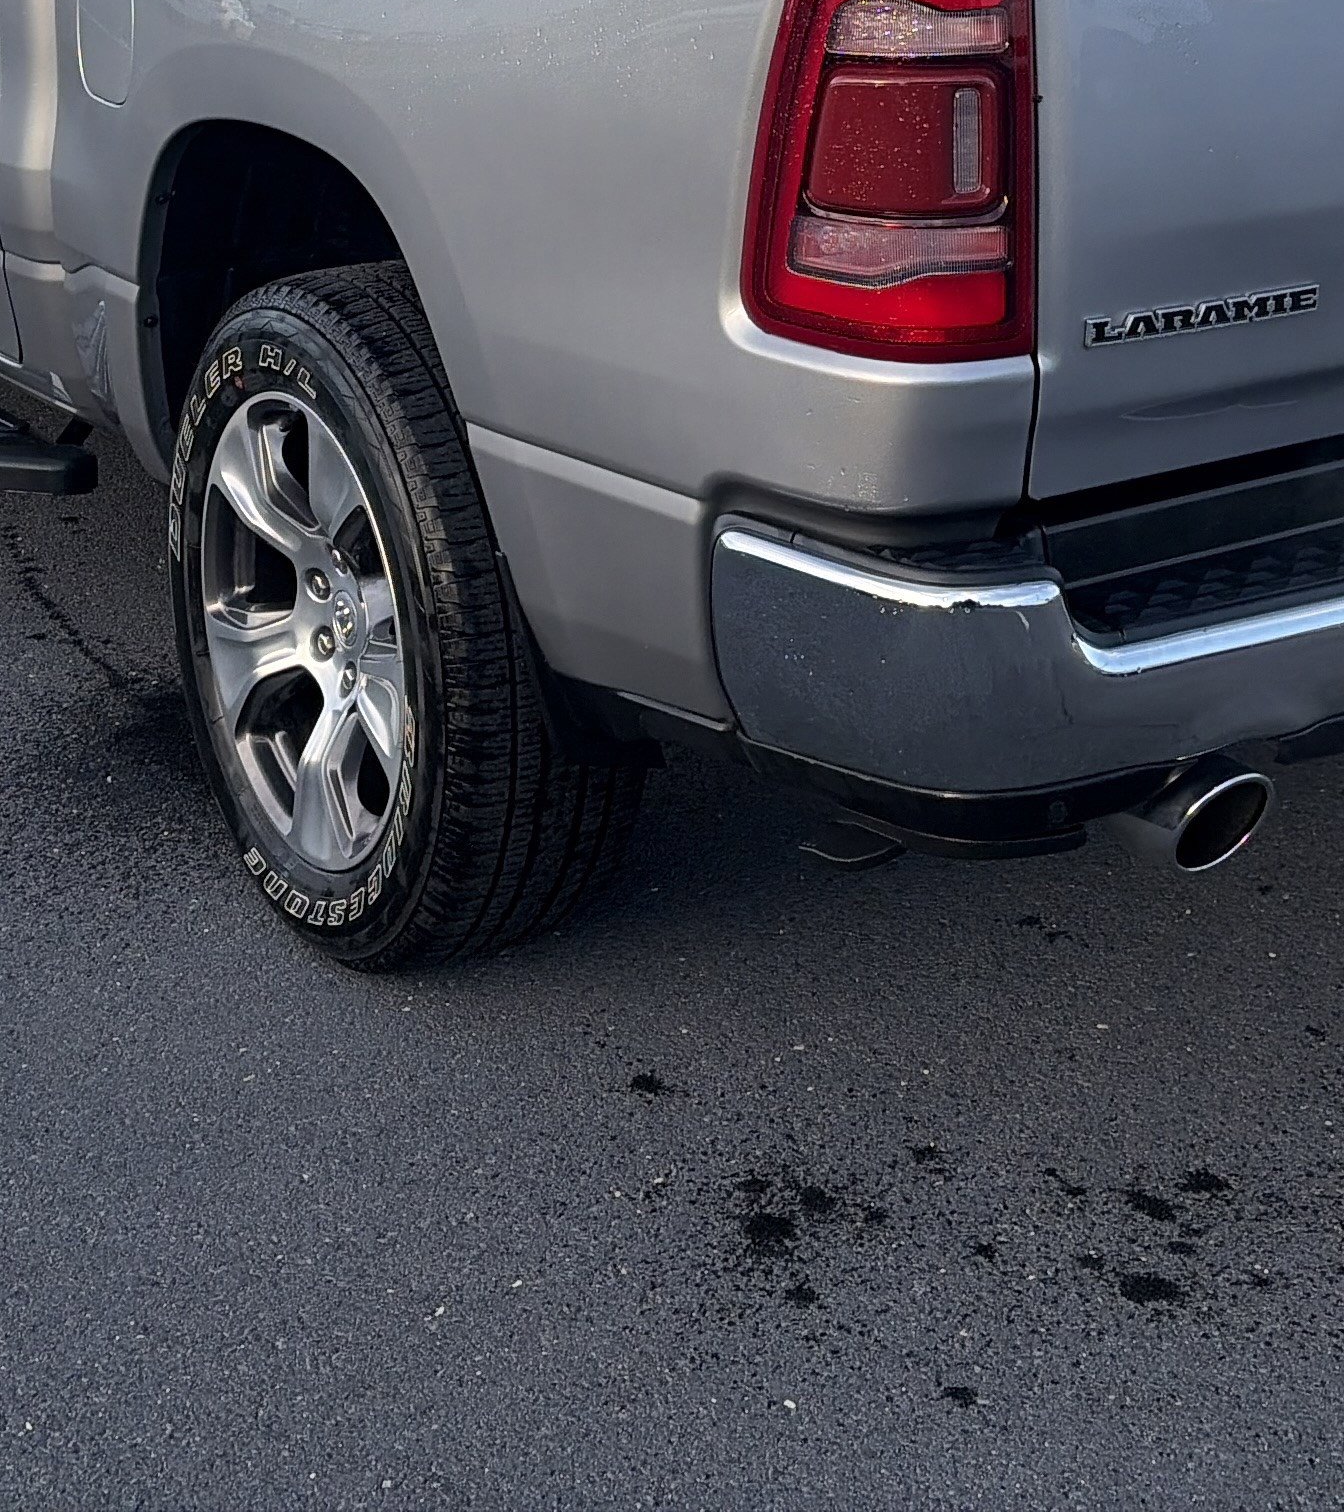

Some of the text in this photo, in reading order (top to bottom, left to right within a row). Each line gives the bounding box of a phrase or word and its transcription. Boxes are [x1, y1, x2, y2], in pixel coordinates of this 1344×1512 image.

[1084, 284, 1319, 347] LARAMIE
[168, 346, 243, 563] DUELER
[243, 695, 416, 926] BRIDGESTONE
